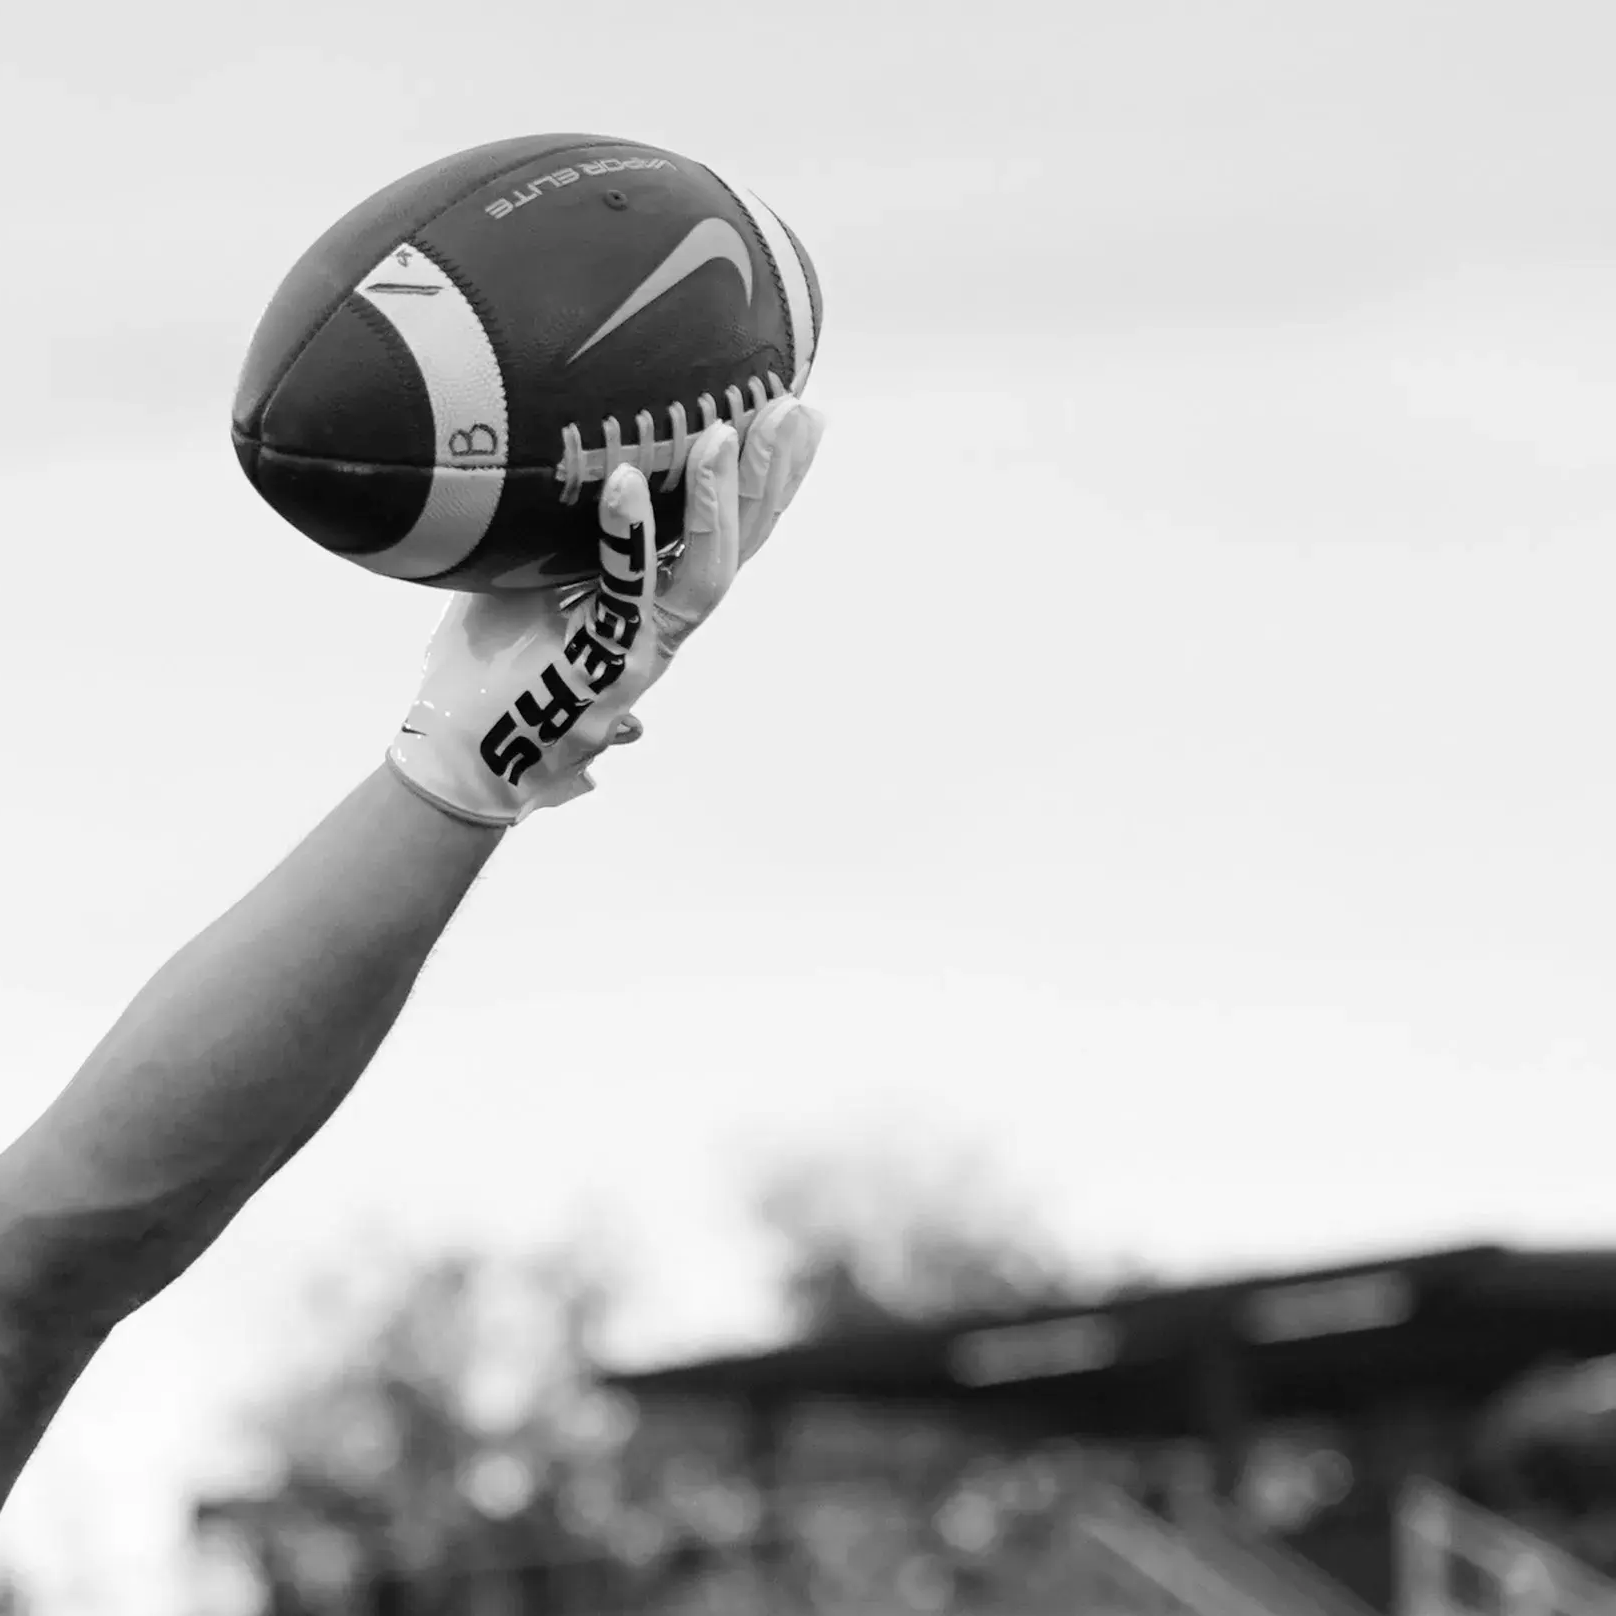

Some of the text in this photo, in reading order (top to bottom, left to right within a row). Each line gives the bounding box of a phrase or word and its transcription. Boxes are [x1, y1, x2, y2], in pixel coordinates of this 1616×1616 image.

[484, 157, 678, 220] VAPOR ELITE
[480, 521, 645, 787] TIGERS
